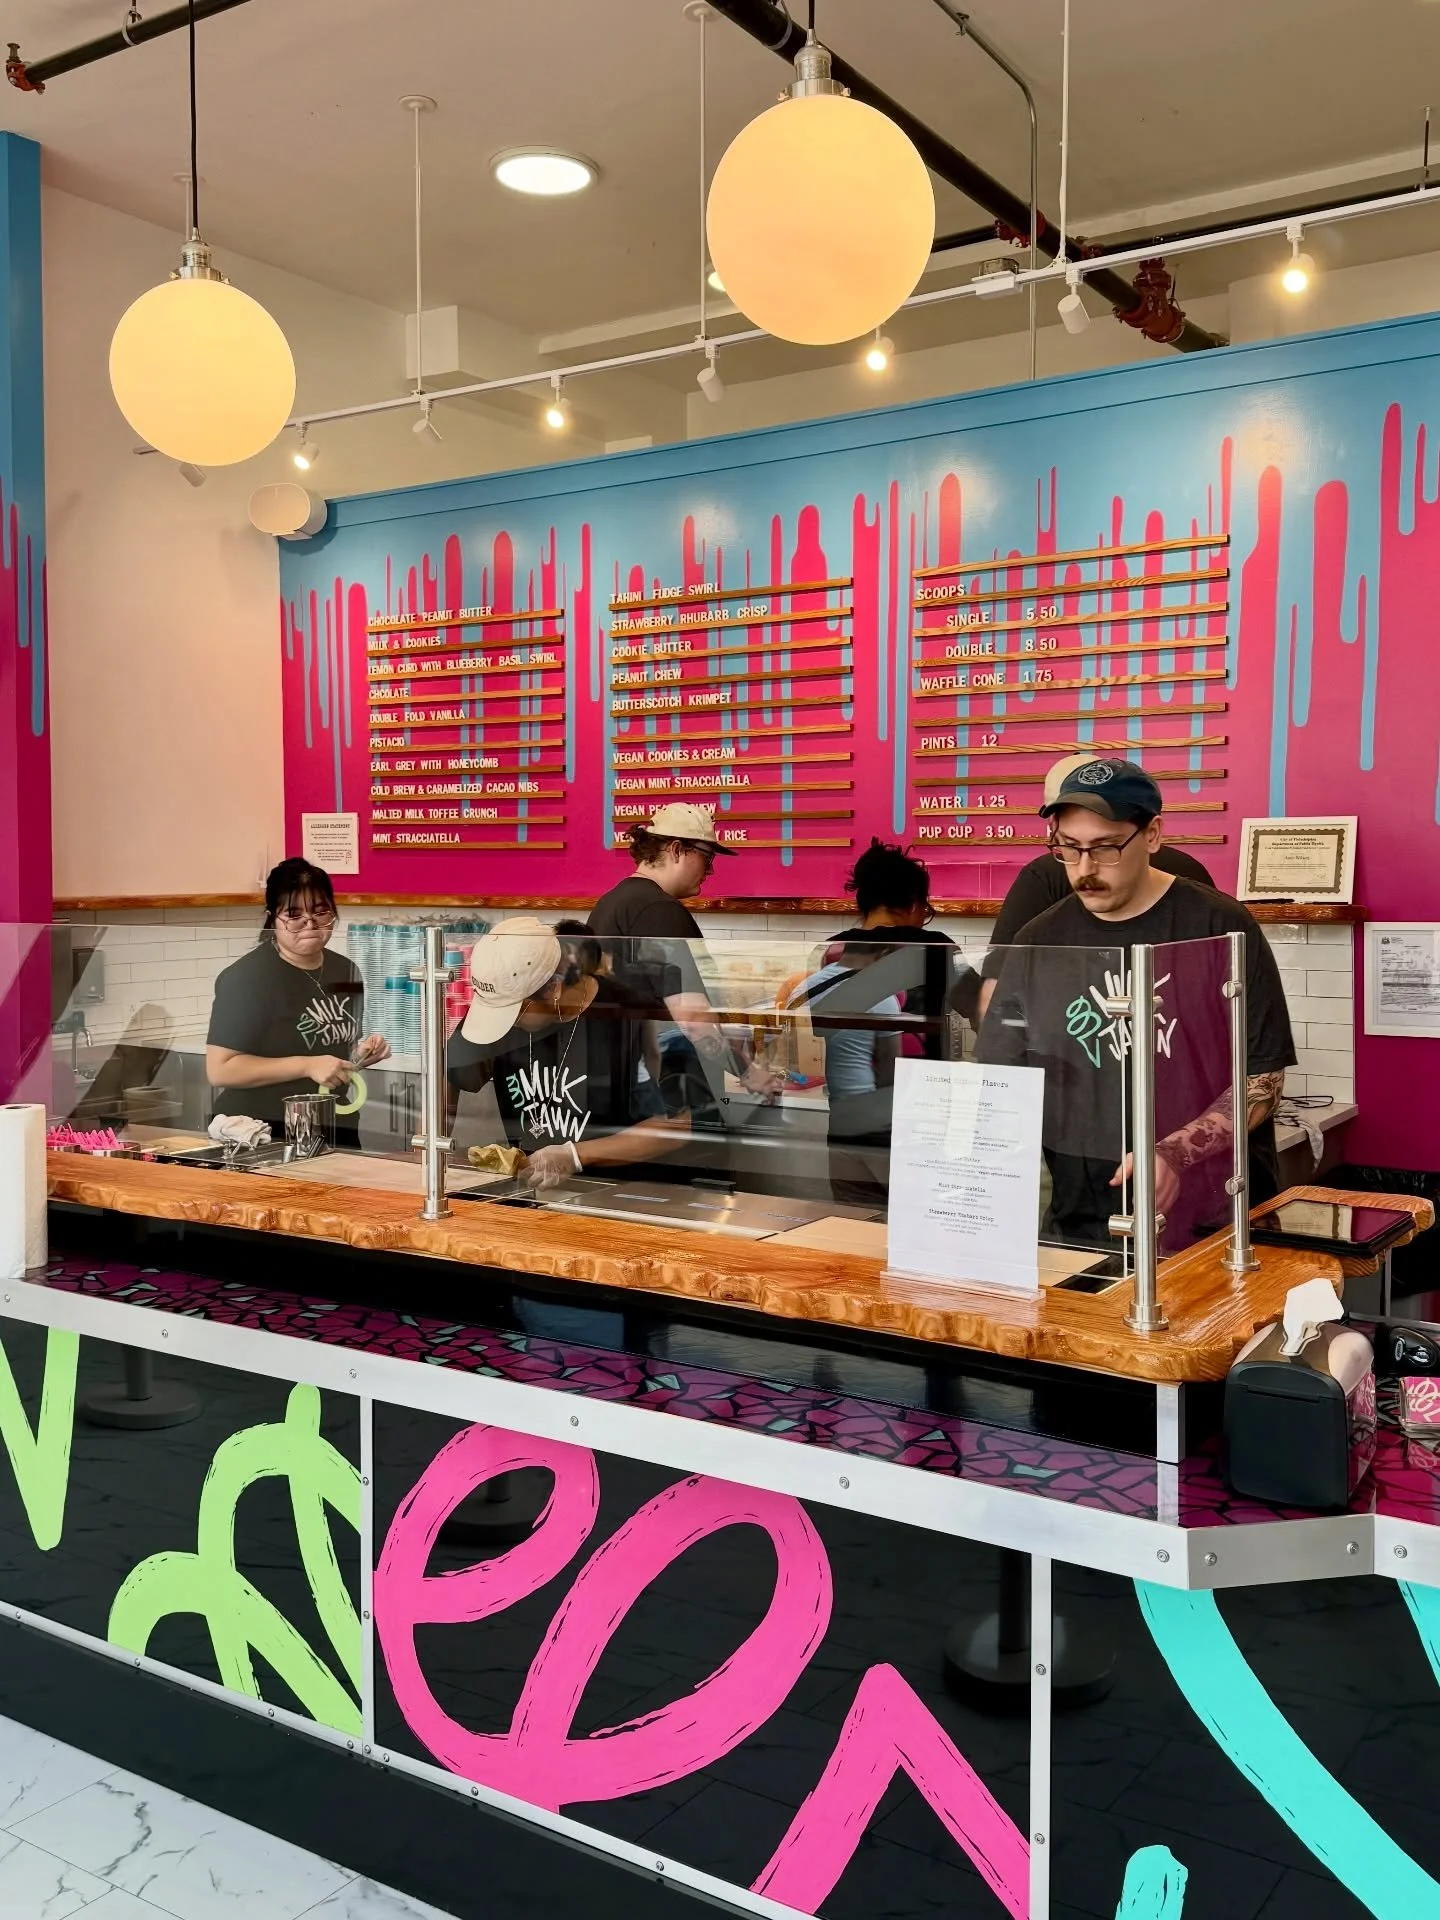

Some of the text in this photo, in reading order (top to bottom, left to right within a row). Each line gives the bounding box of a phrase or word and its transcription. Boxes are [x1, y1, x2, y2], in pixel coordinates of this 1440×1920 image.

[610, 582, 721, 604] TAHINI FUDGE SWIRL
[915, 584, 966, 600] SCOOPS
[368, 606, 492, 627] CHOCOLATE PEANUT BUTTER
[611, 605, 768, 631] STRAWBERRY RHUBARB CRISP
[946, 606, 1058, 627] SINGLE 5.50
[368, 636, 441, 651] MILK & COOKIES
[612, 641, 692, 658] COOKIE BUTTER
[945, 637, 1058, 658] DOUBLE 8.50
[368, 652, 558, 676] LEMON CURD WITH BLUEBERRY BASIL SWIRL
[612, 668, 683, 685] PEANUT CHEW
[920, 669, 1053, 690] WAFFLE CONE 1.75
[612, 692, 731, 711] BUTTERSCOTCH KRIMPET
[369, 709, 465, 724] DOUBLE FOLD VANILLA
[369, 737, 405, 748] PISTACIO
[921, 734, 998, 749] PINTS 12
[613, 748, 736, 764] VEGAN COOKIES & CREAM
[370, 758, 499, 772] EARL GREY WITH HONEYCOMB
[370, 781, 539, 796] COLD BREW & CARAMELIZED CACAO NIBS
[614, 775, 750, 790] VEGAN MINT STRACCIATELLA
[919, 795, 1006, 809] WATER 1.25
[372, 807, 498, 820] MALTED MILK TOFFEE CRUNCH
[614, 805, 645, 817] VEGAN
[372, 833, 461, 844] MINT STRACCIATELLA
[724, 829, 748, 841] RICE
[918, 825, 1015, 839] PUP CUP 3.50
[306, 994, 357, 1025] MILK
[519, 1060, 588, 1114] MILK
